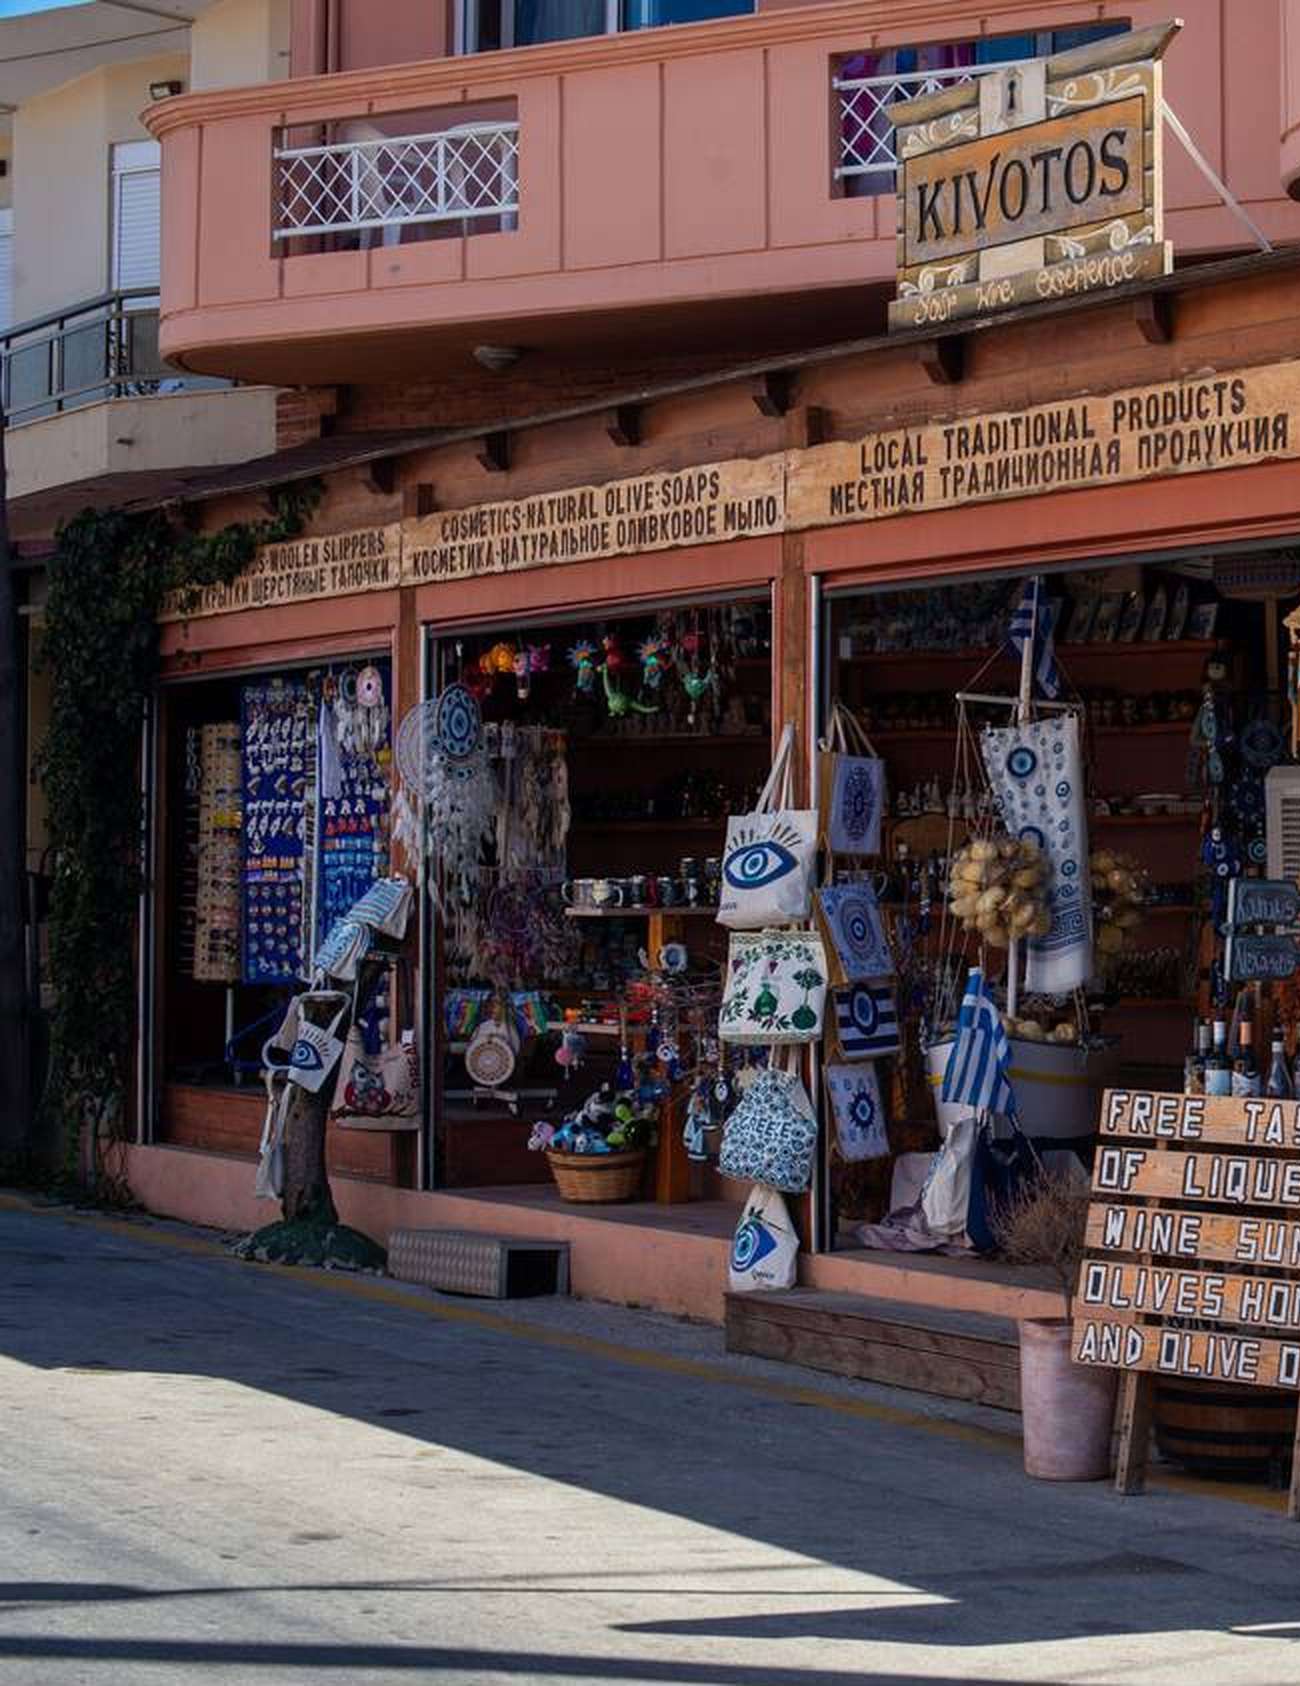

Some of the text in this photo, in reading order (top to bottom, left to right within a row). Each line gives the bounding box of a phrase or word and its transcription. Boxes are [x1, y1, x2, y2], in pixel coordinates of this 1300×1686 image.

[917, 130, 1128, 243] KIVOTOS
[860, 378, 1247, 475] LOCAL TRADITIONAL PRODUCTS
[829, 413, 1289, 517] МЕСТНАЯ ТРАДИЦИОННАЯ ПРОДУКЦИЯ
[441, 471, 720, 542] COSMETICS NATURAL OLIVE SOAPS
[322, 531, 385, 563] SLIPPERS
[413, 496, 777, 577] КОСМЕТИКА НАТУРАЛЬНОЕ ОЛИВКОВОЕ МЫЛО
[1107, 1093, 1205, 1138] FREE
[1099, 1149, 1145, 1190] OF
[1104, 1208, 1201, 1255] WINE
[1084, 1264, 1225, 1316] OLIVES
[1079, 1323, 1144, 1366] AND
[1159, 1330, 1260, 1380] OLIVE
